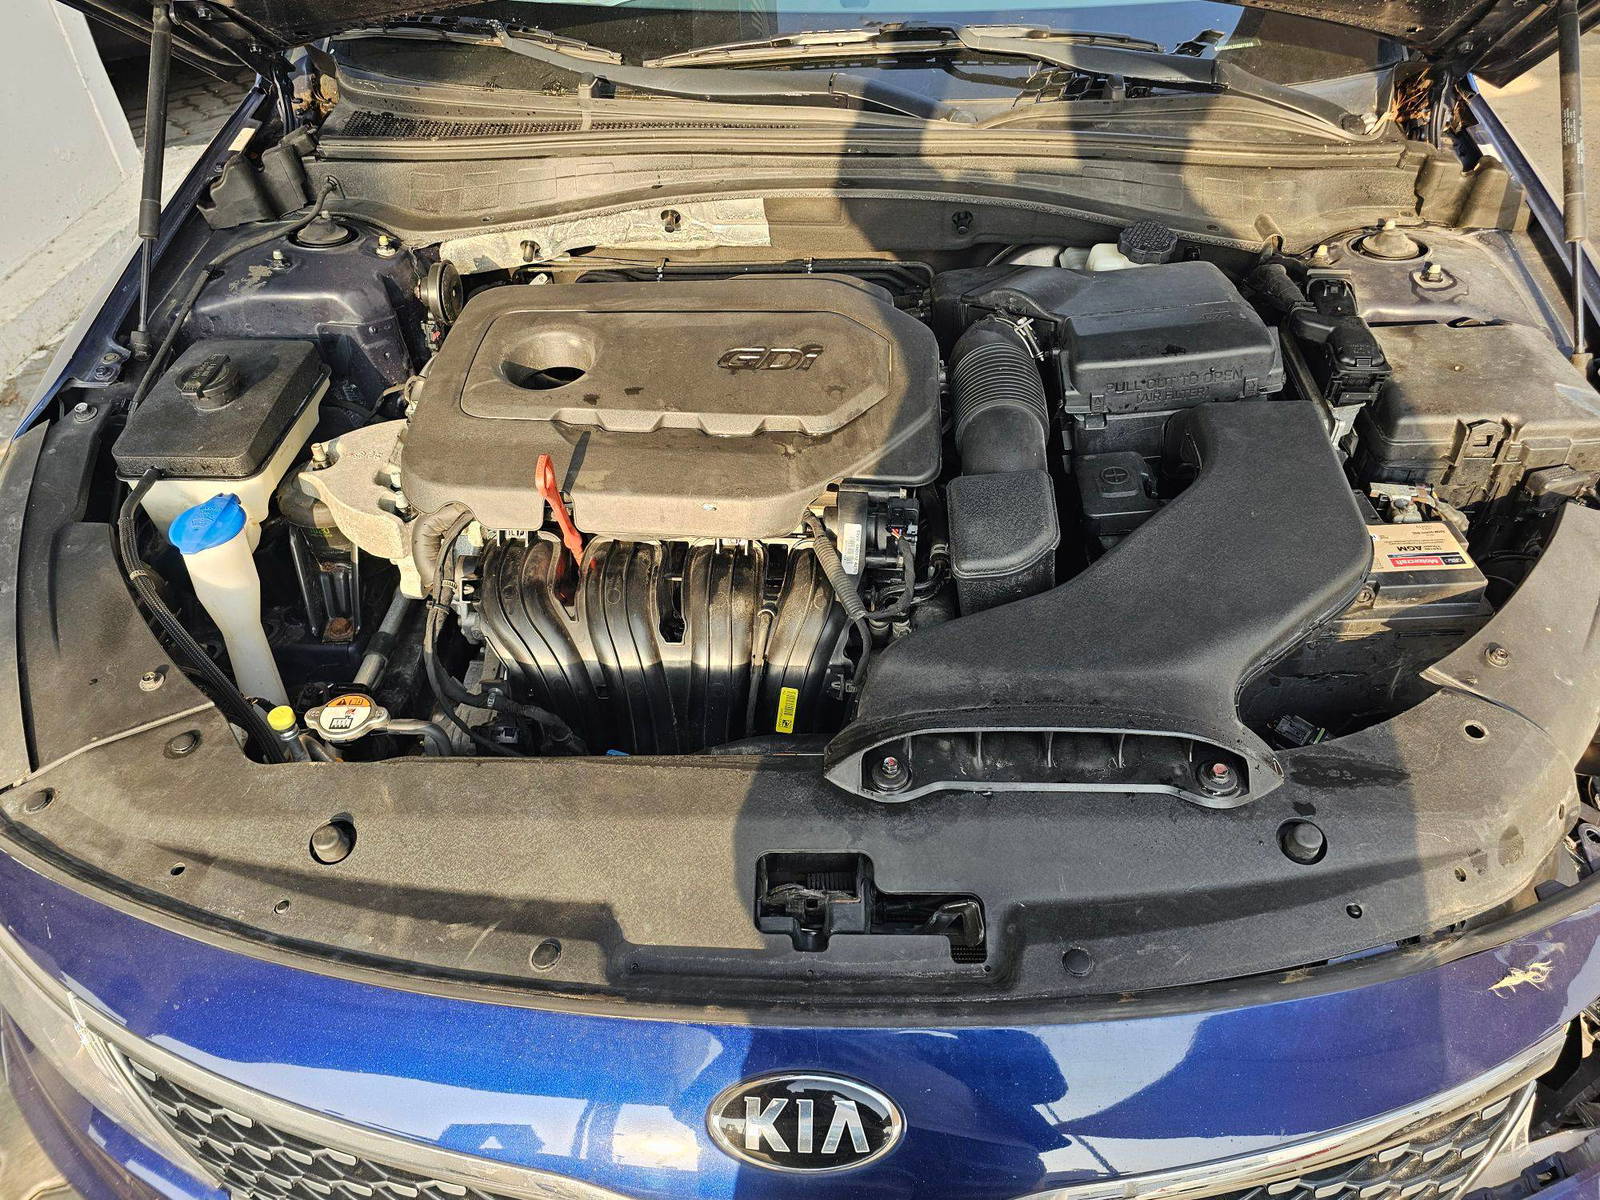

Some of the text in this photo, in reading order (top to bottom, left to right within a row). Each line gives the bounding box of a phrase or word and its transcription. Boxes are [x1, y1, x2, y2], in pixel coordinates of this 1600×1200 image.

[717, 344, 824, 371] GDi
[1106, 380, 1142, 393] PULL
[1180, 371, 1199, 386] TO
[1203, 365, 1244, 383] OPEN
[744, 1096, 870, 1154] KIA
